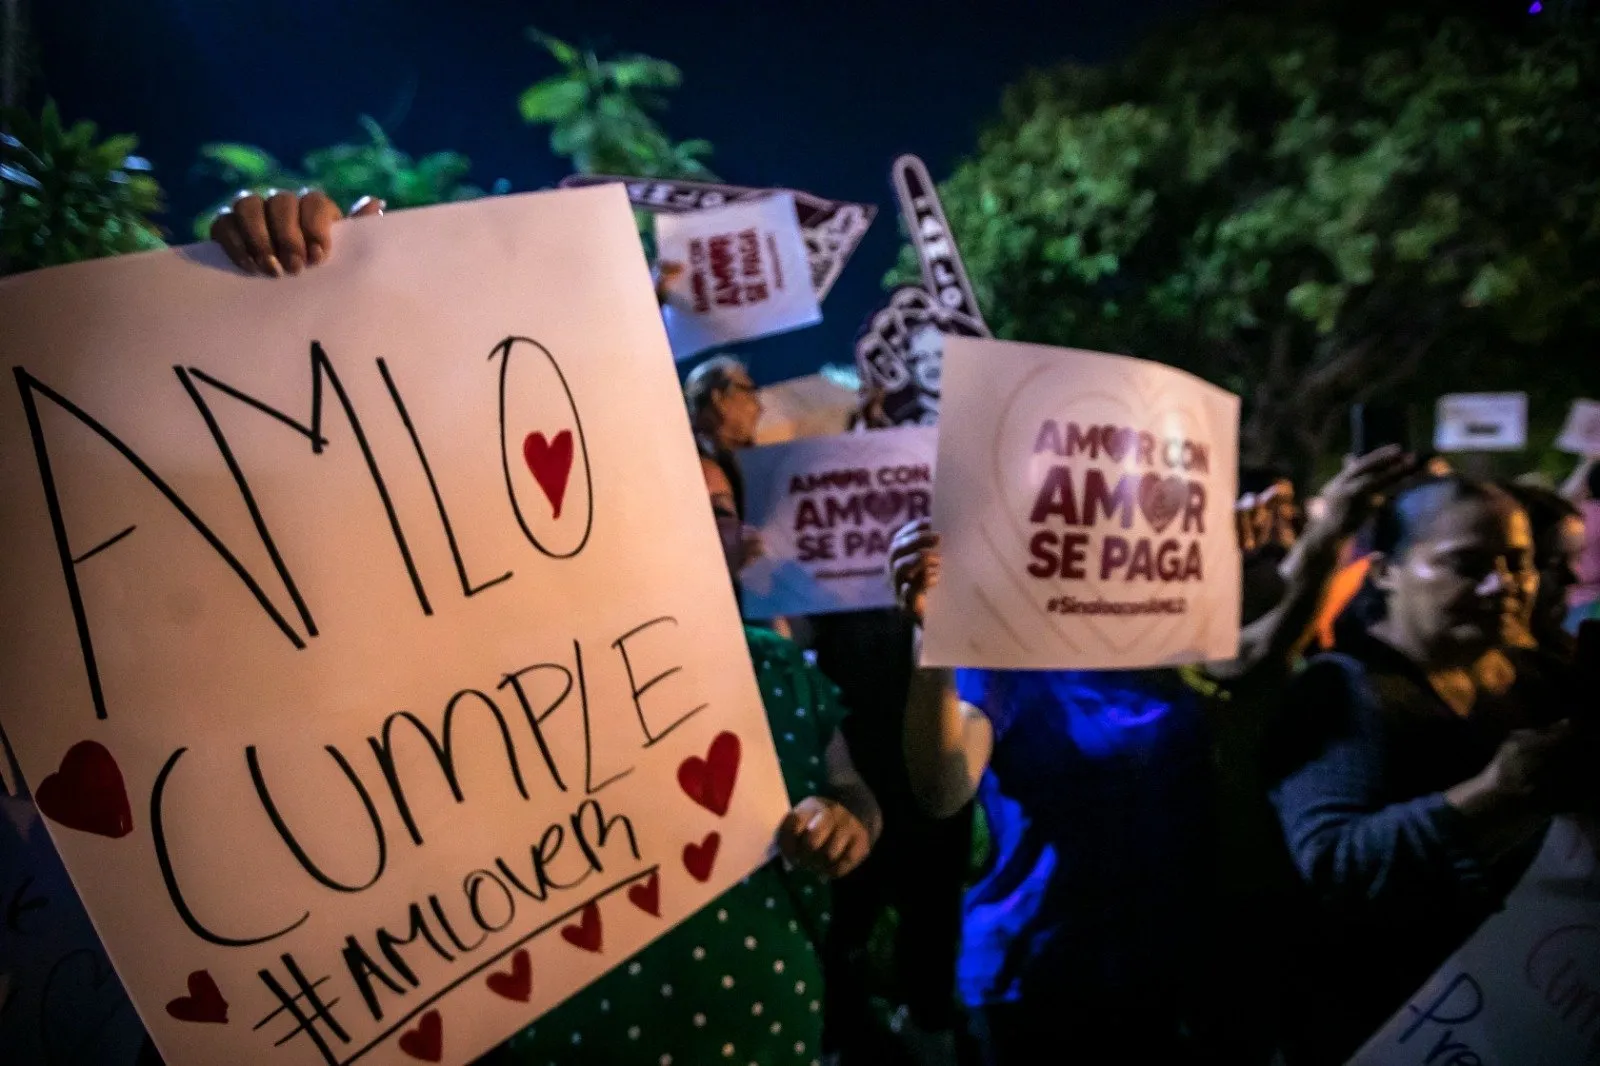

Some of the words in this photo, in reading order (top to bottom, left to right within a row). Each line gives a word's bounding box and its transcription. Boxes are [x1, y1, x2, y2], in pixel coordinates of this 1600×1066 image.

[876, 463, 931, 487] CON
[1029, 464, 1206, 534] AMOR
[12, 335, 594, 721] AMLO
[797, 532, 836, 562] SE
[1027, 530, 1089, 580] SE
[1100, 535, 1204, 583] PAGA
[149, 616, 709, 948] CUMPLE
